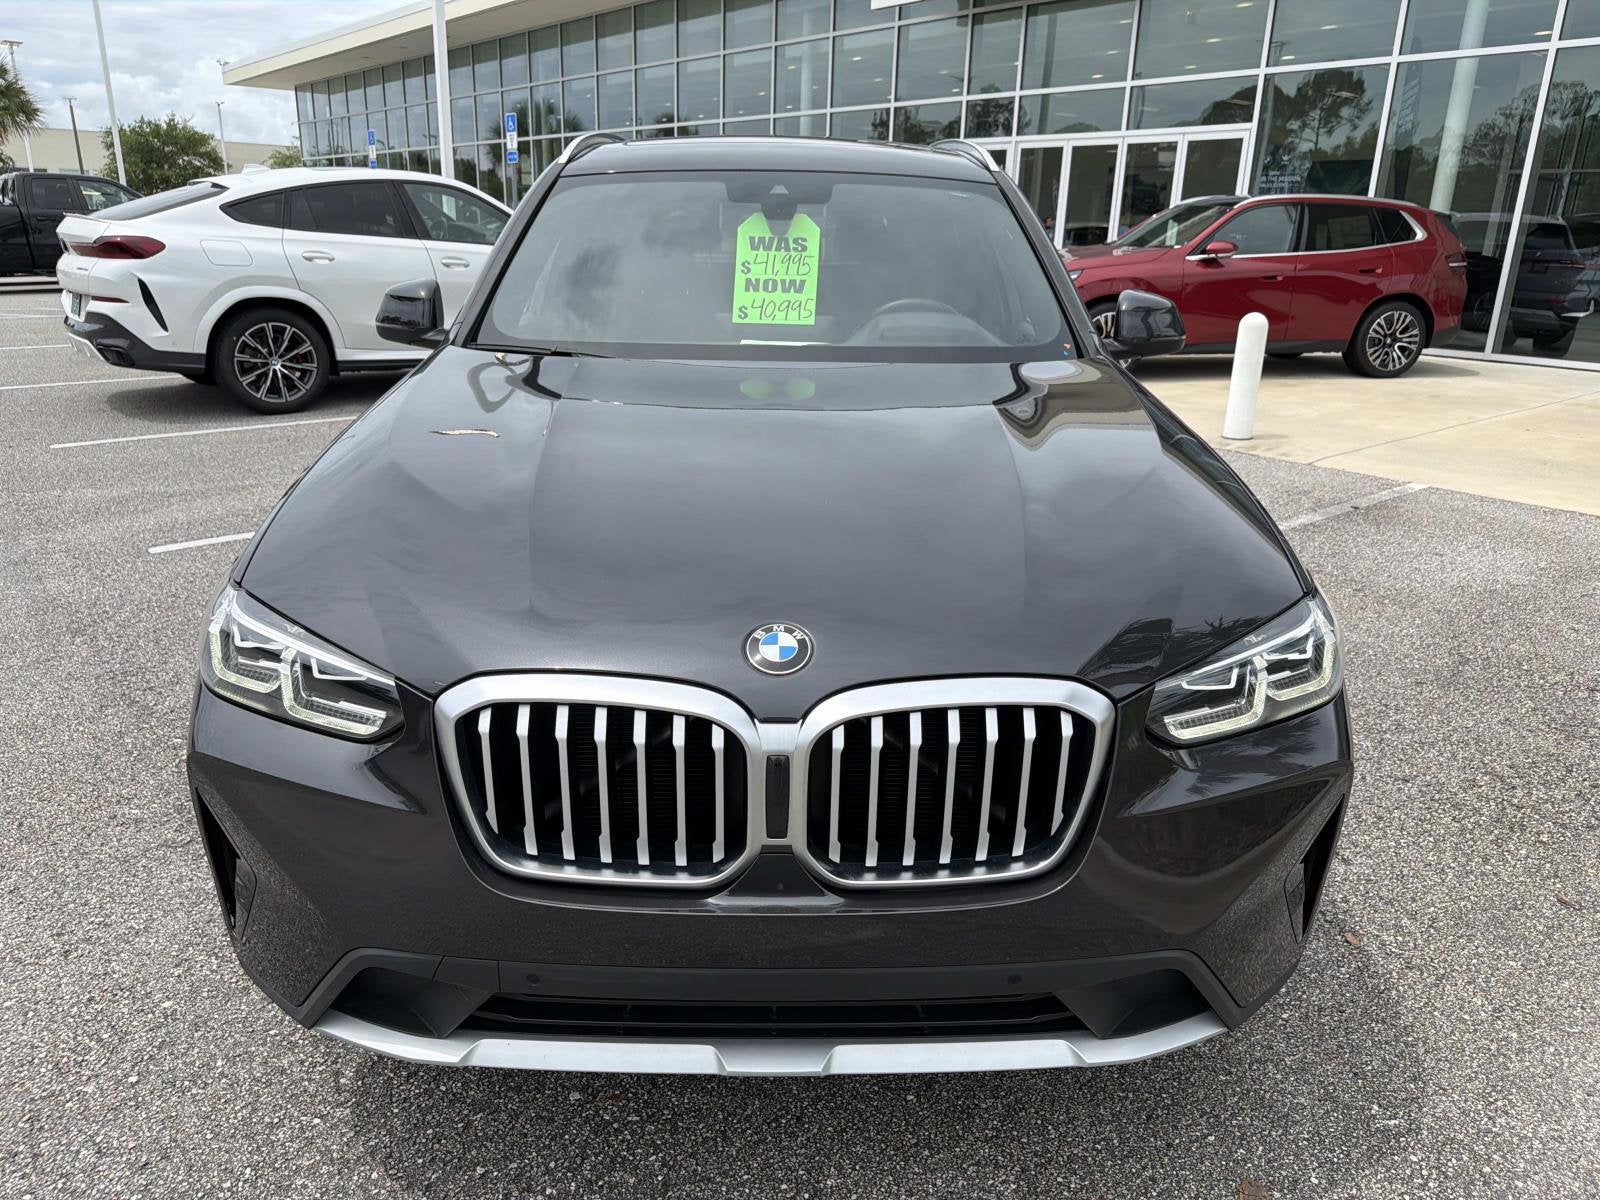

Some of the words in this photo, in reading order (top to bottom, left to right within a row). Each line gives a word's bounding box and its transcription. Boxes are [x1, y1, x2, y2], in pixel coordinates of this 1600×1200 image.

[749, 236, 808, 253] WAS
[744, 278, 806, 294] NOW
[753, 624, 804, 640] BMW
